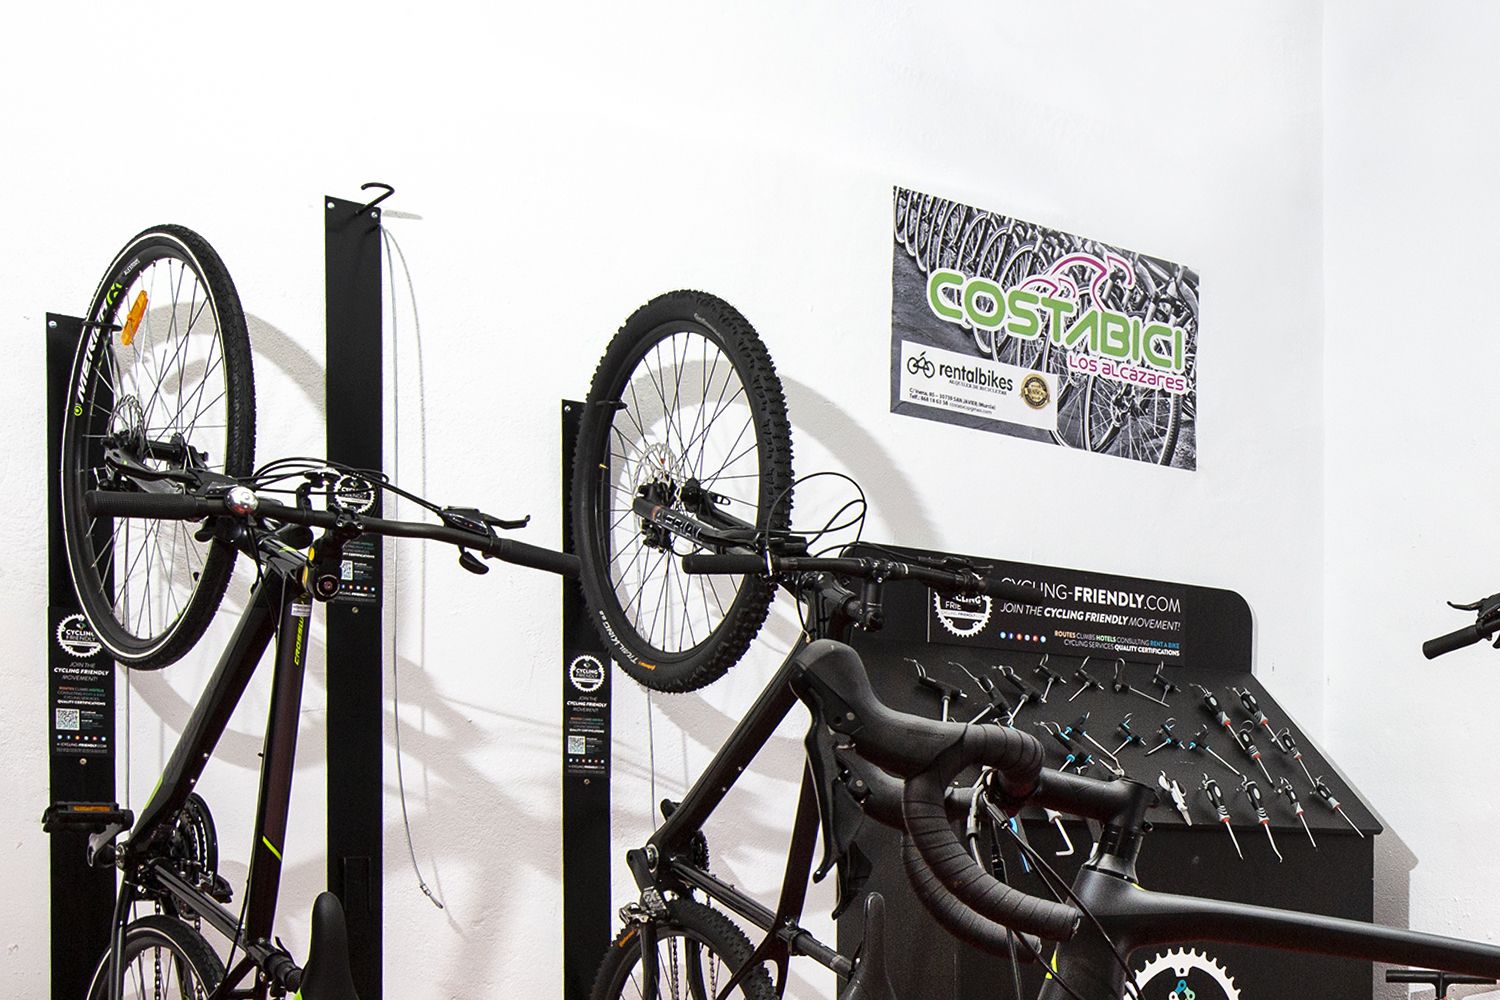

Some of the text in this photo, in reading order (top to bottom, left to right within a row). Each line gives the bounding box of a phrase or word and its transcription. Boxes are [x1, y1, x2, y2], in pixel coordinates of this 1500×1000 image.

[930, 271, 1183, 371] COSTABICI
[939, 362, 1013, 391] rentalbikes
[1001, 577, 1181, 614] ING-FRIENDLY.COM
[1000, 602, 1181, 631] JOIN THE CYCLING FRIENDLY MOVEMENT!
[1054, 630, 1076, 639] ROUTES
[1096, 634, 1116, 643] HOTELS
[1114, 644, 1138, 653] QUALITY
[1137, 646, 1180, 657] CERTIFICATIONS
